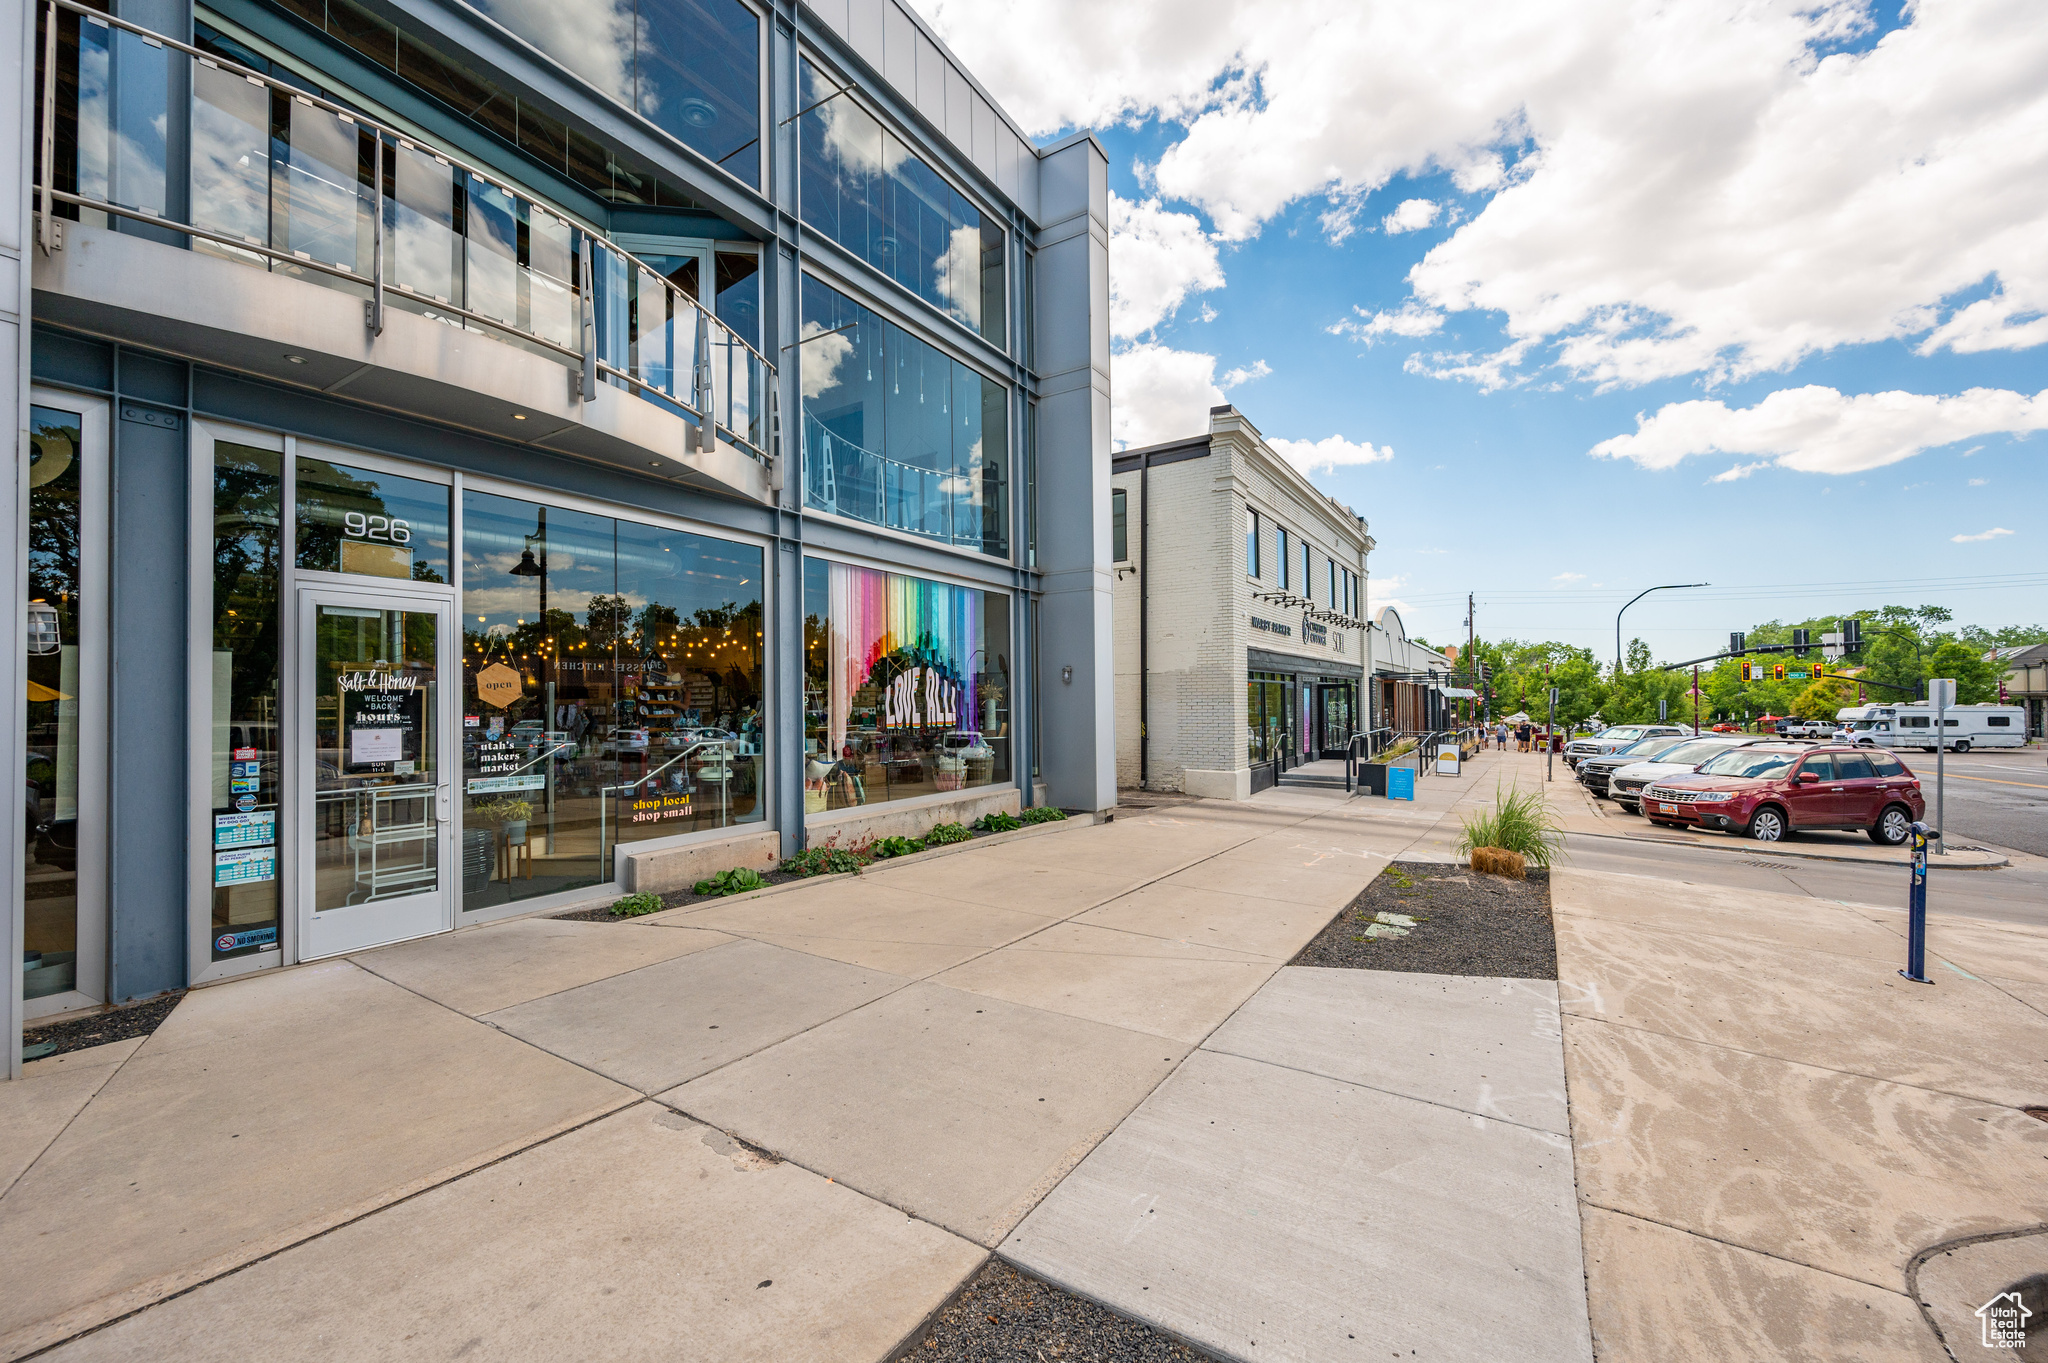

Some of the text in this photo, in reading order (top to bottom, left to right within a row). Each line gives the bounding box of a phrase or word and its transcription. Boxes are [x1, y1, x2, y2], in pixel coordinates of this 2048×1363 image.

[345, 512, 410, 543] 926
[1272, 622, 1291, 636] PARKER
[338, 669, 417, 696] Salt & Honey
[486, 682, 512, 690] open
[885, 667, 920, 729] LOVE
[357, 711, 400, 721] hours
[480, 741, 514, 751] utah's
[480, 753, 520, 762] makers
[480, 763, 519, 773] market
[633, 794, 690, 810] shop local
[633, 805, 692, 822] shop small
[237, 932, 275, 945] NO SMOKING
